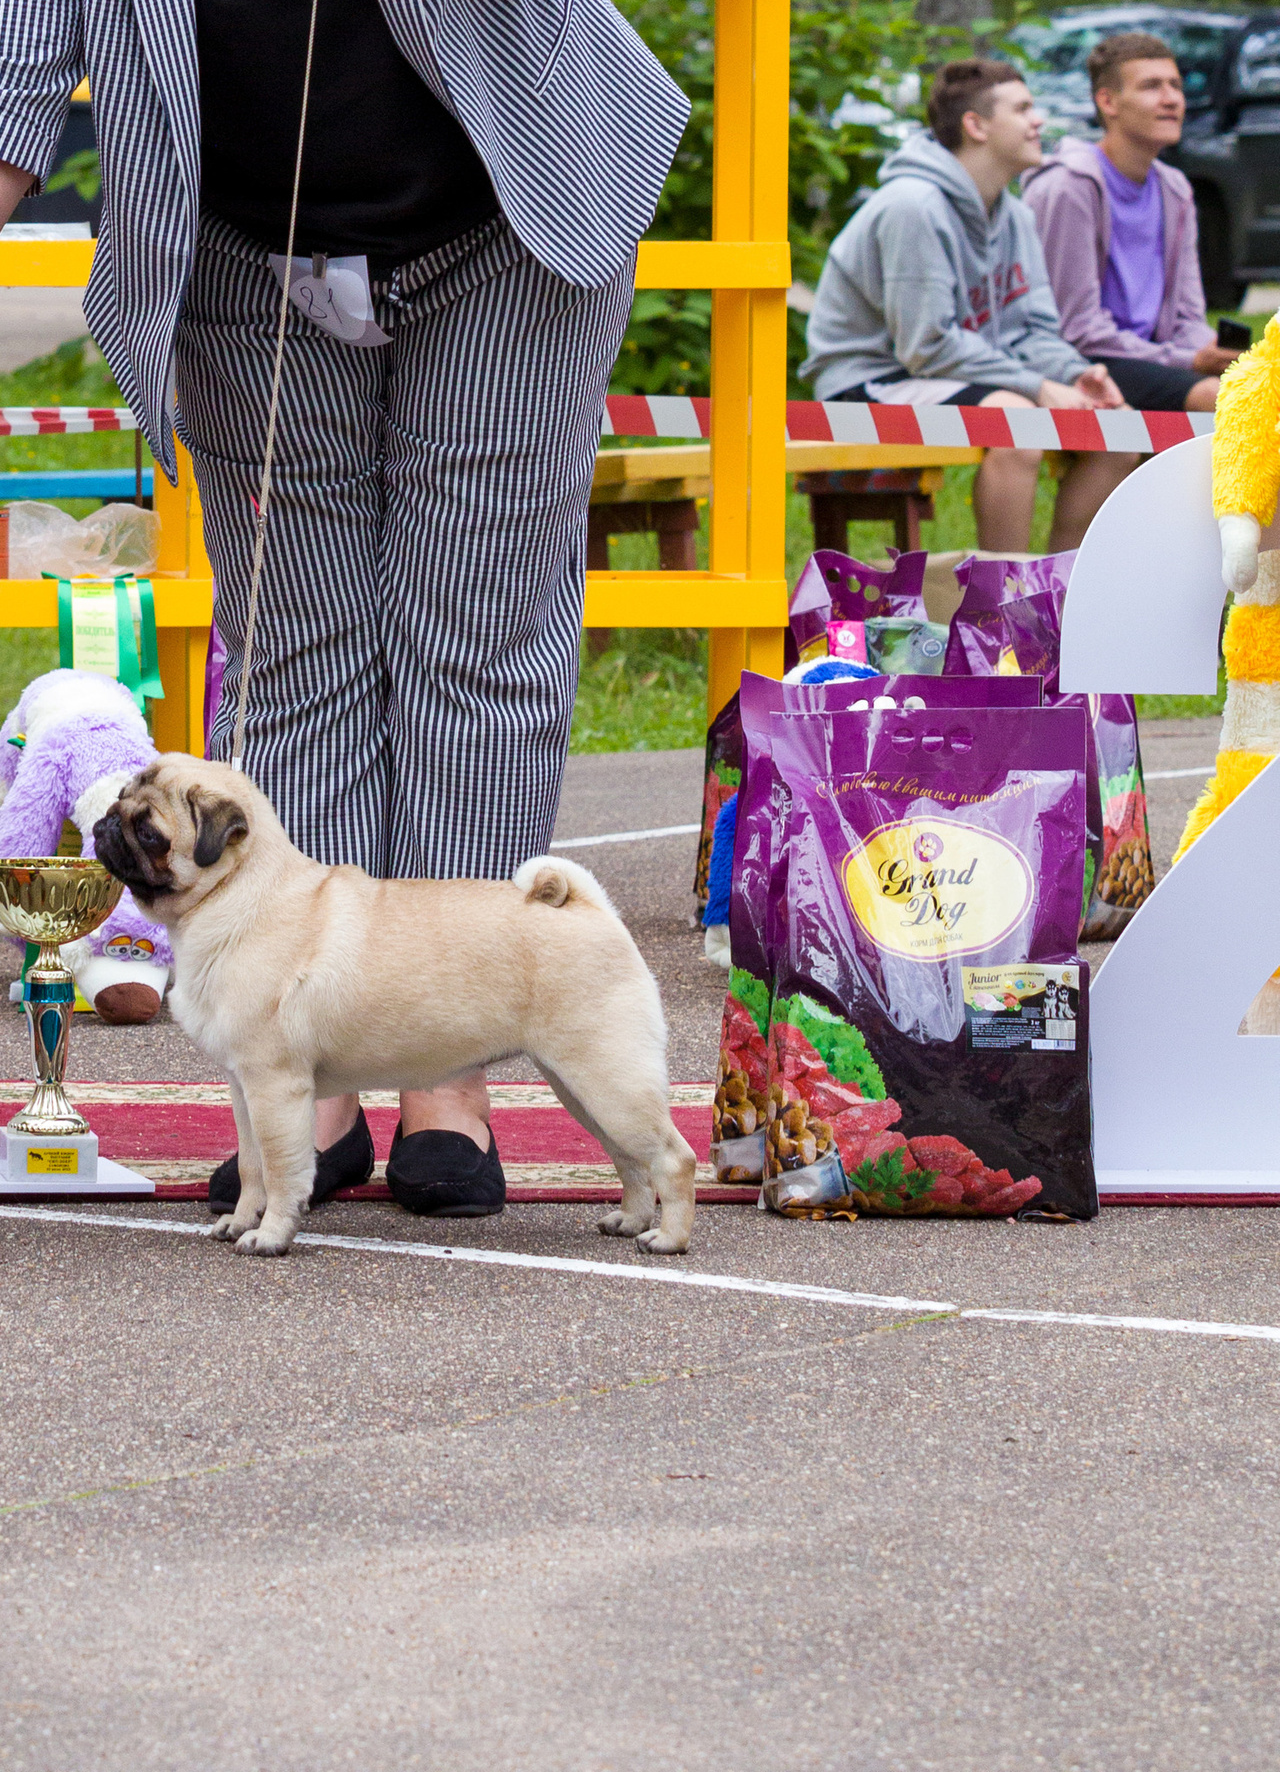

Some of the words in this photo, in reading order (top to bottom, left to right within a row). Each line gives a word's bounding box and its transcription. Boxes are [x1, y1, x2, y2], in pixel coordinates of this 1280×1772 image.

[300, 286, 342, 324] 81
[816, 783, 829, 799] С
[832, 771, 889, 797] любовью
[902, 777, 957, 803] вашим
[959, 778, 1042, 805] питомцам
[877, 857, 979, 897] Grand
[900, 890, 968, 932] Dog
[910, 939, 928, 948] КОРМ
[929, 935, 943, 947] ДЛЯ
[942, 932, 964, 944] СОБАК
[968, 972, 1001, 985] Junior
